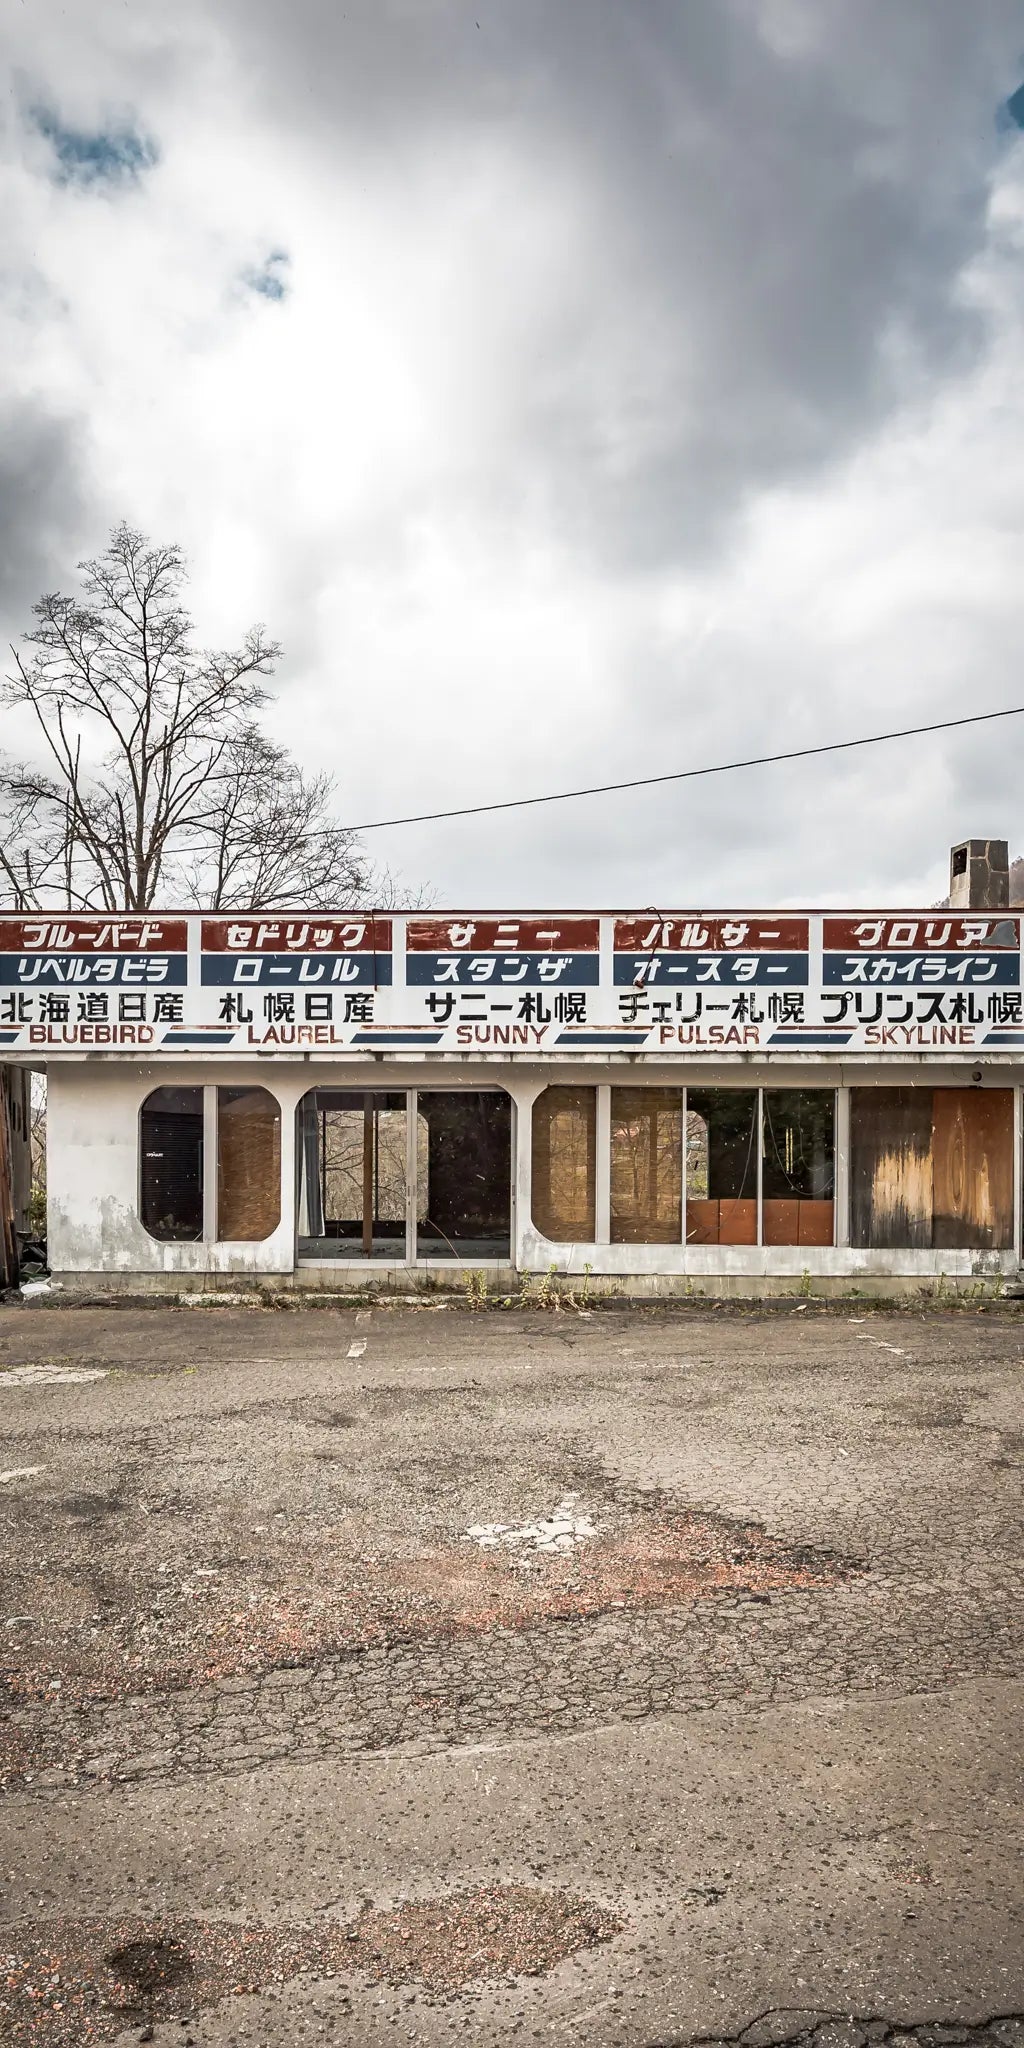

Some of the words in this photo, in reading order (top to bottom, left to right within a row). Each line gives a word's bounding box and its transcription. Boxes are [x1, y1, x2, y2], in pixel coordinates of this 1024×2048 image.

[227, 924, 366, 948] セドリック
[447, 923, 561, 947] サニー
[640, 922, 781, 947] パルサー
[853, 921, 989, 947] グロリア
[17, 958, 169, 982] リベルタビラ
[233, 958, 360, 982] ローレル
[433, 957, 573, 982] スタンザ
[633, 958, 789, 982] オースター
[841, 958, 998, 982] スカイライン
[1, 992, 184, 1023] 北海道日産
[218, 992, 375, 1023] 札幌日産
[425, 992, 588, 1023] サニー札幌
[618, 992, 805, 1023] チェリー札幌
[820, 991, 1024, 1023] プリンス札幌
[29, 1025, 155, 1044] BLUEBIRD
[247, 1025, 344, 1044] LAUREL
[456, 1025, 550, 1044] SUNNY
[659, 1025, 760, 1044] PULSAR
[864, 1025, 976, 1044] SKYLINE
